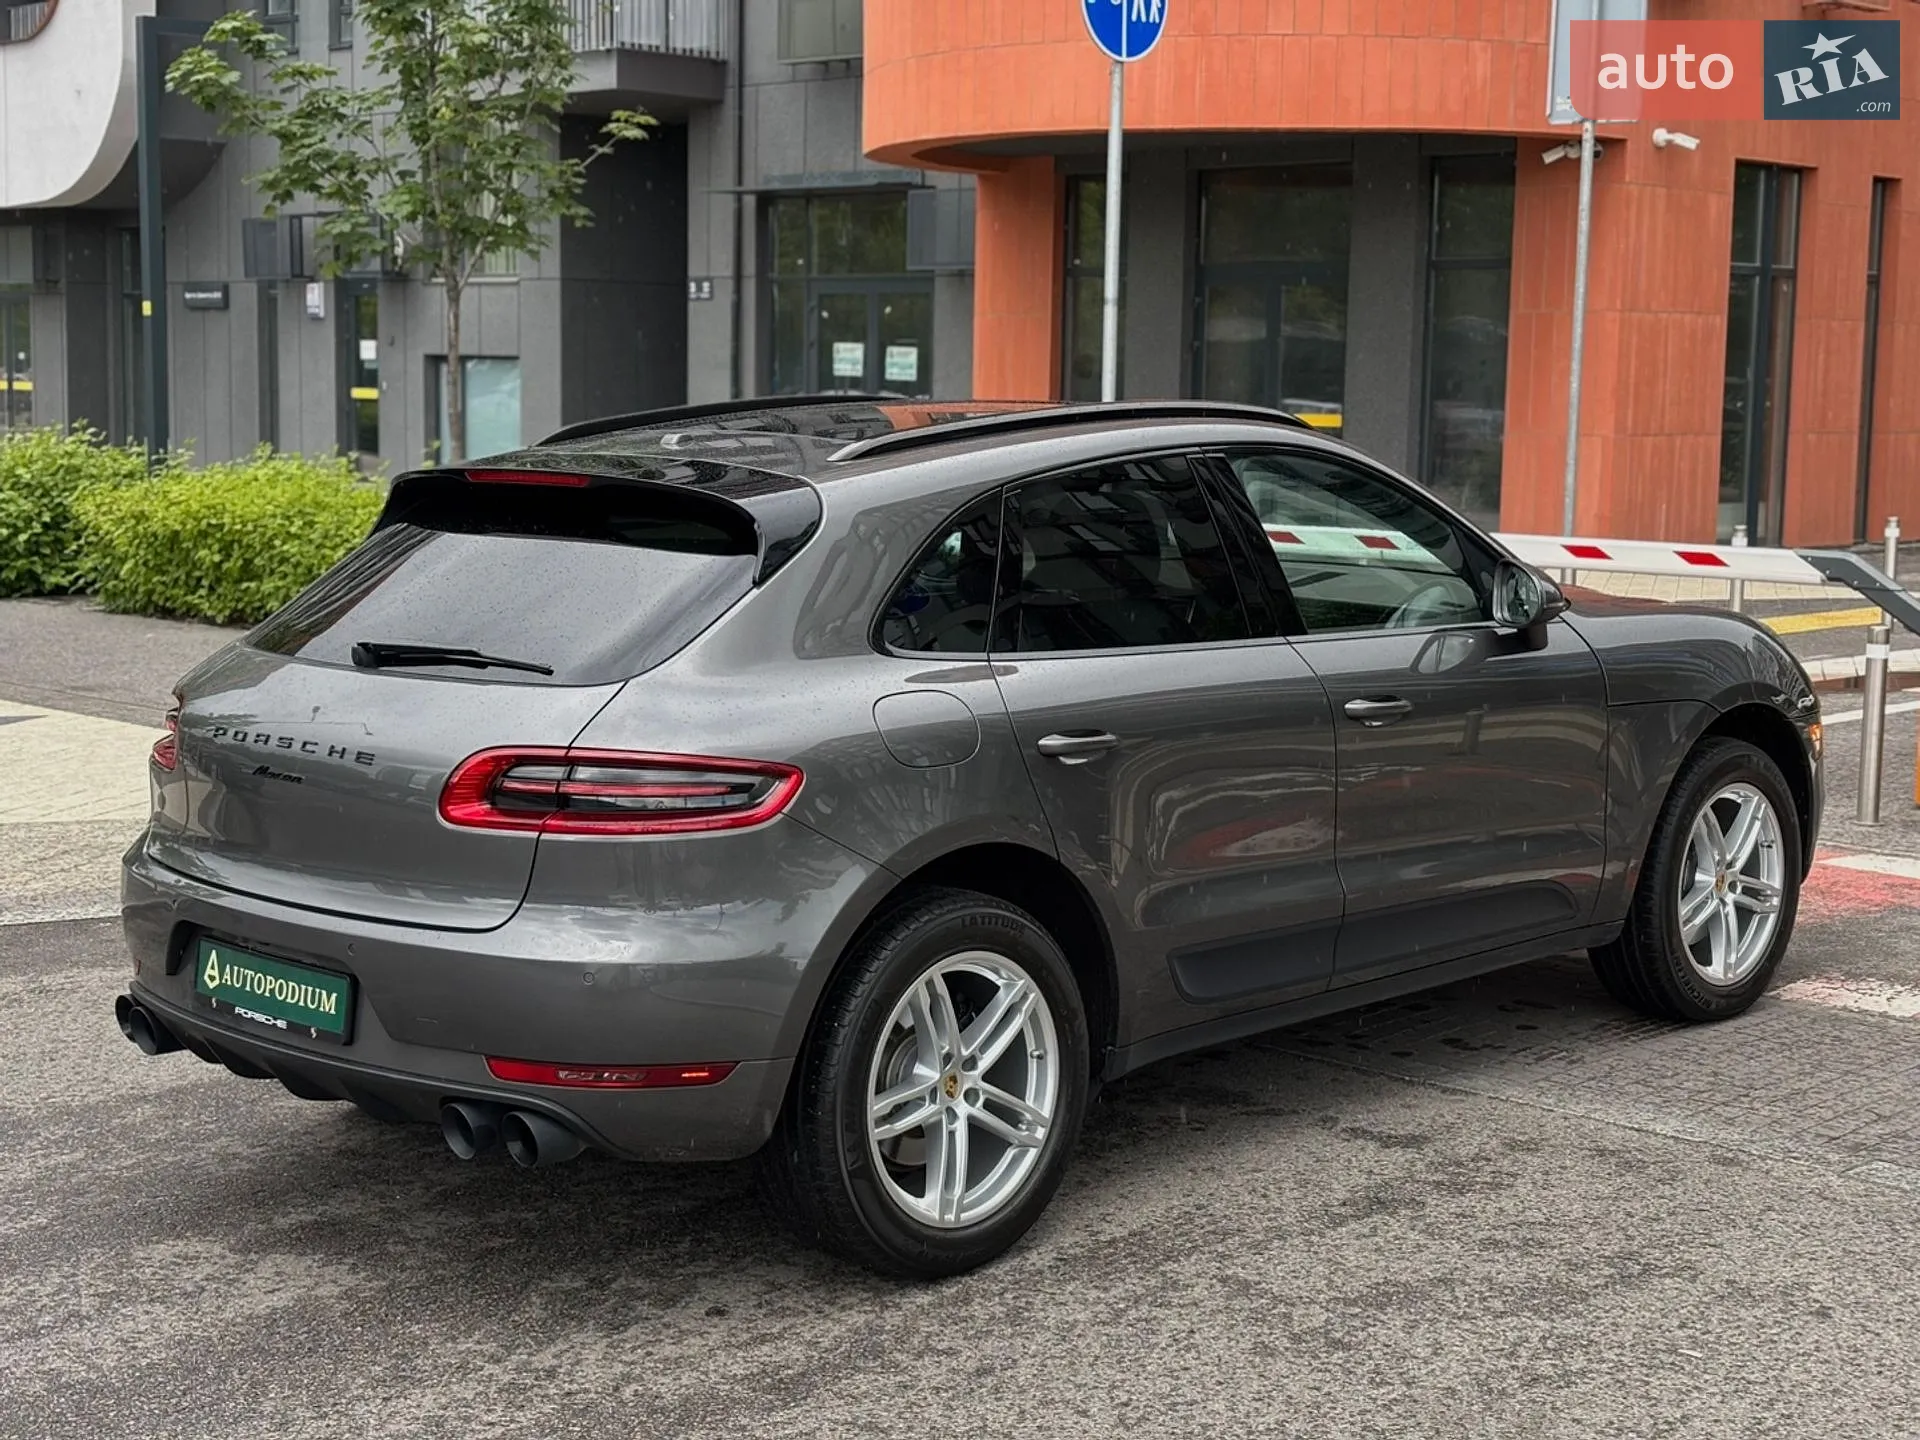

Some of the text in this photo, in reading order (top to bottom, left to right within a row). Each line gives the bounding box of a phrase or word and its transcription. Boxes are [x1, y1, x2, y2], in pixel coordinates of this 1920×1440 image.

[213, 726, 376, 766] PORSCHE
[252, 764, 304, 784] Macan
[221, 963, 338, 1015] AUTOPODIUM
[234, 1006, 288, 1030] PORSCHE
